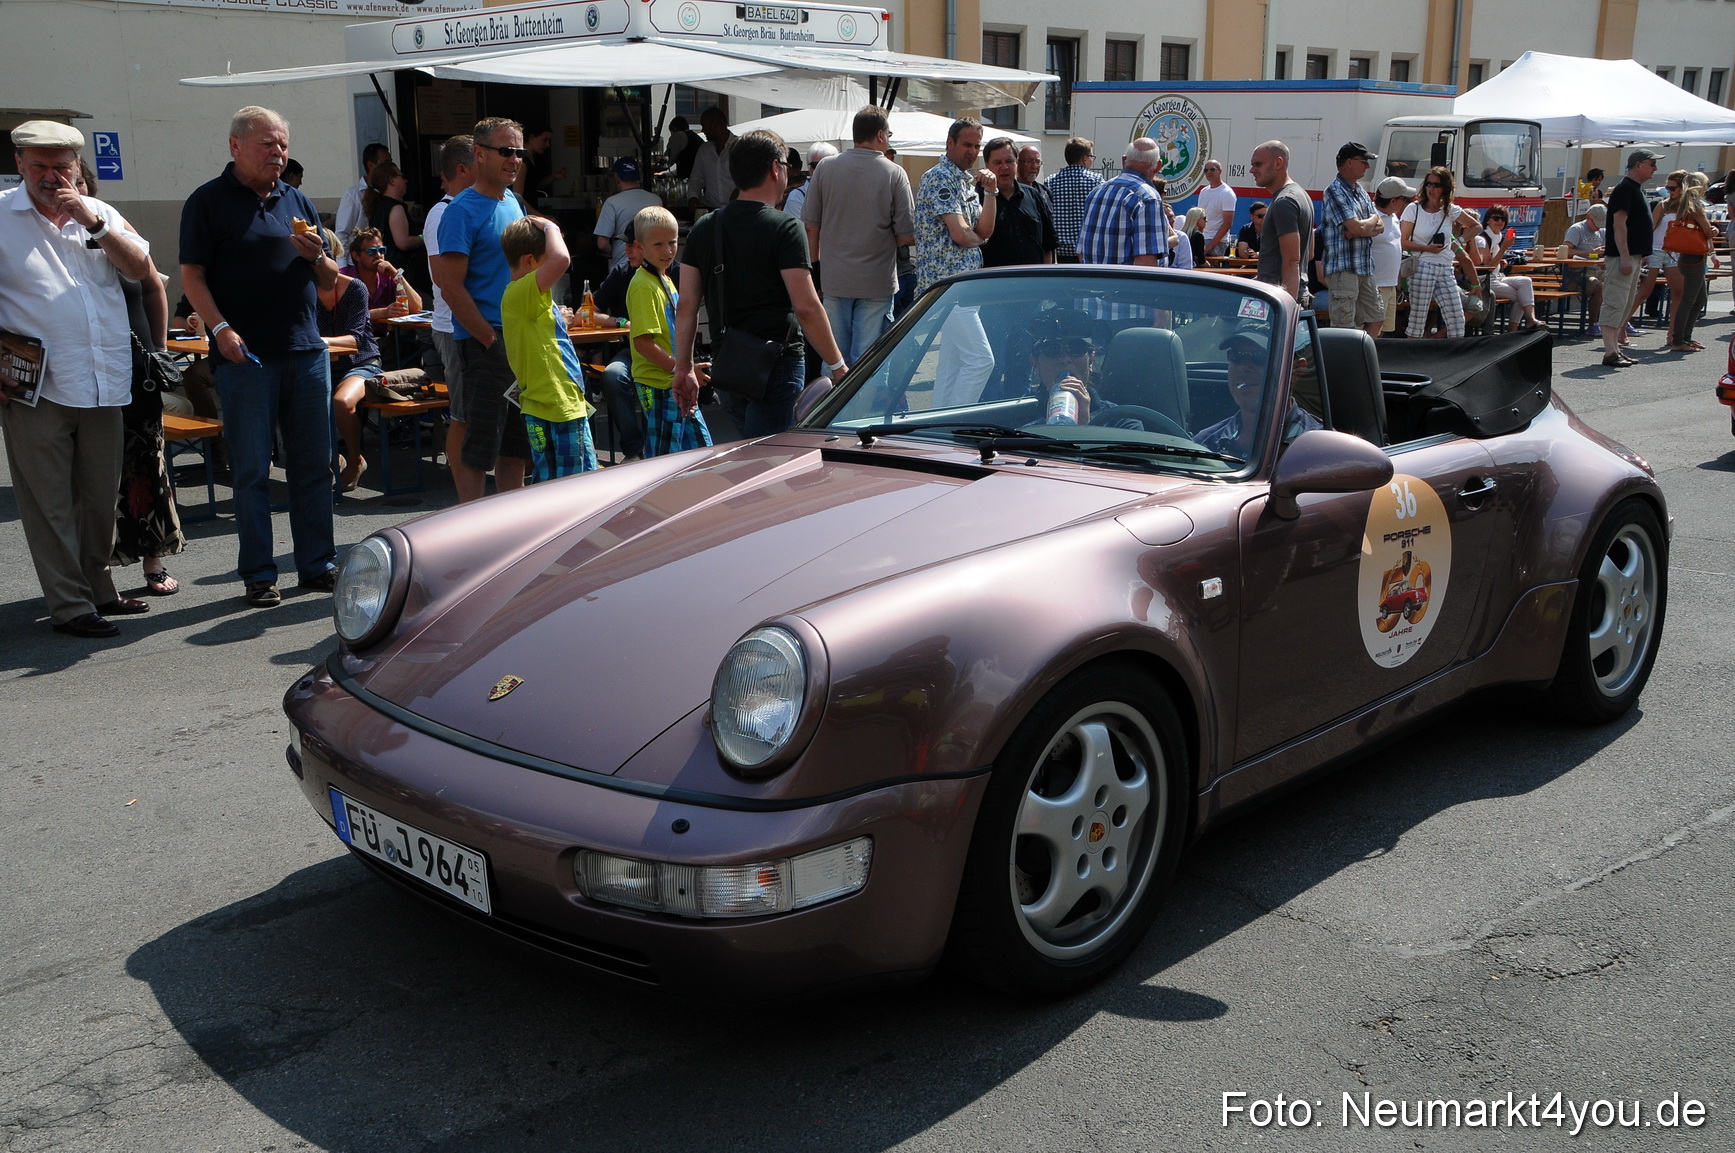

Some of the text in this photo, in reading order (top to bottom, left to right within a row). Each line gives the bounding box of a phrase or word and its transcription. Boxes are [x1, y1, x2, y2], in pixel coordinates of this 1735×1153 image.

[276, 0, 338, 10] CLASSIC
[346, 3, 410, 13] www.ofenwerk.de
[747, 7, 796, 21] BA EL 642
[490, 17, 509, 41] Bräu
[514, 12, 564, 38] Buttenheim
[733, 25, 759, 40] Georgen
[760, 27, 776, 39] Bräu
[780, 28, 815, 42] Buttenheim
[1180, 99, 1197, 121] Bräu
[95, 134, 111, 154] P
[1101, 158, 1245, 177] Seit 1624
[1390, 481, 1417, 520] 36
[1383, 525, 1431, 543] PORSCHE
[1401, 538, 1414, 549] 911
[1389, 626, 1413, 639] JAHRE
[339, 821, 346, 833] D
[346, 802, 469, 896] FÜ J 964
[467, 858, 480, 873] 05
[472, 889, 483, 903] 10
